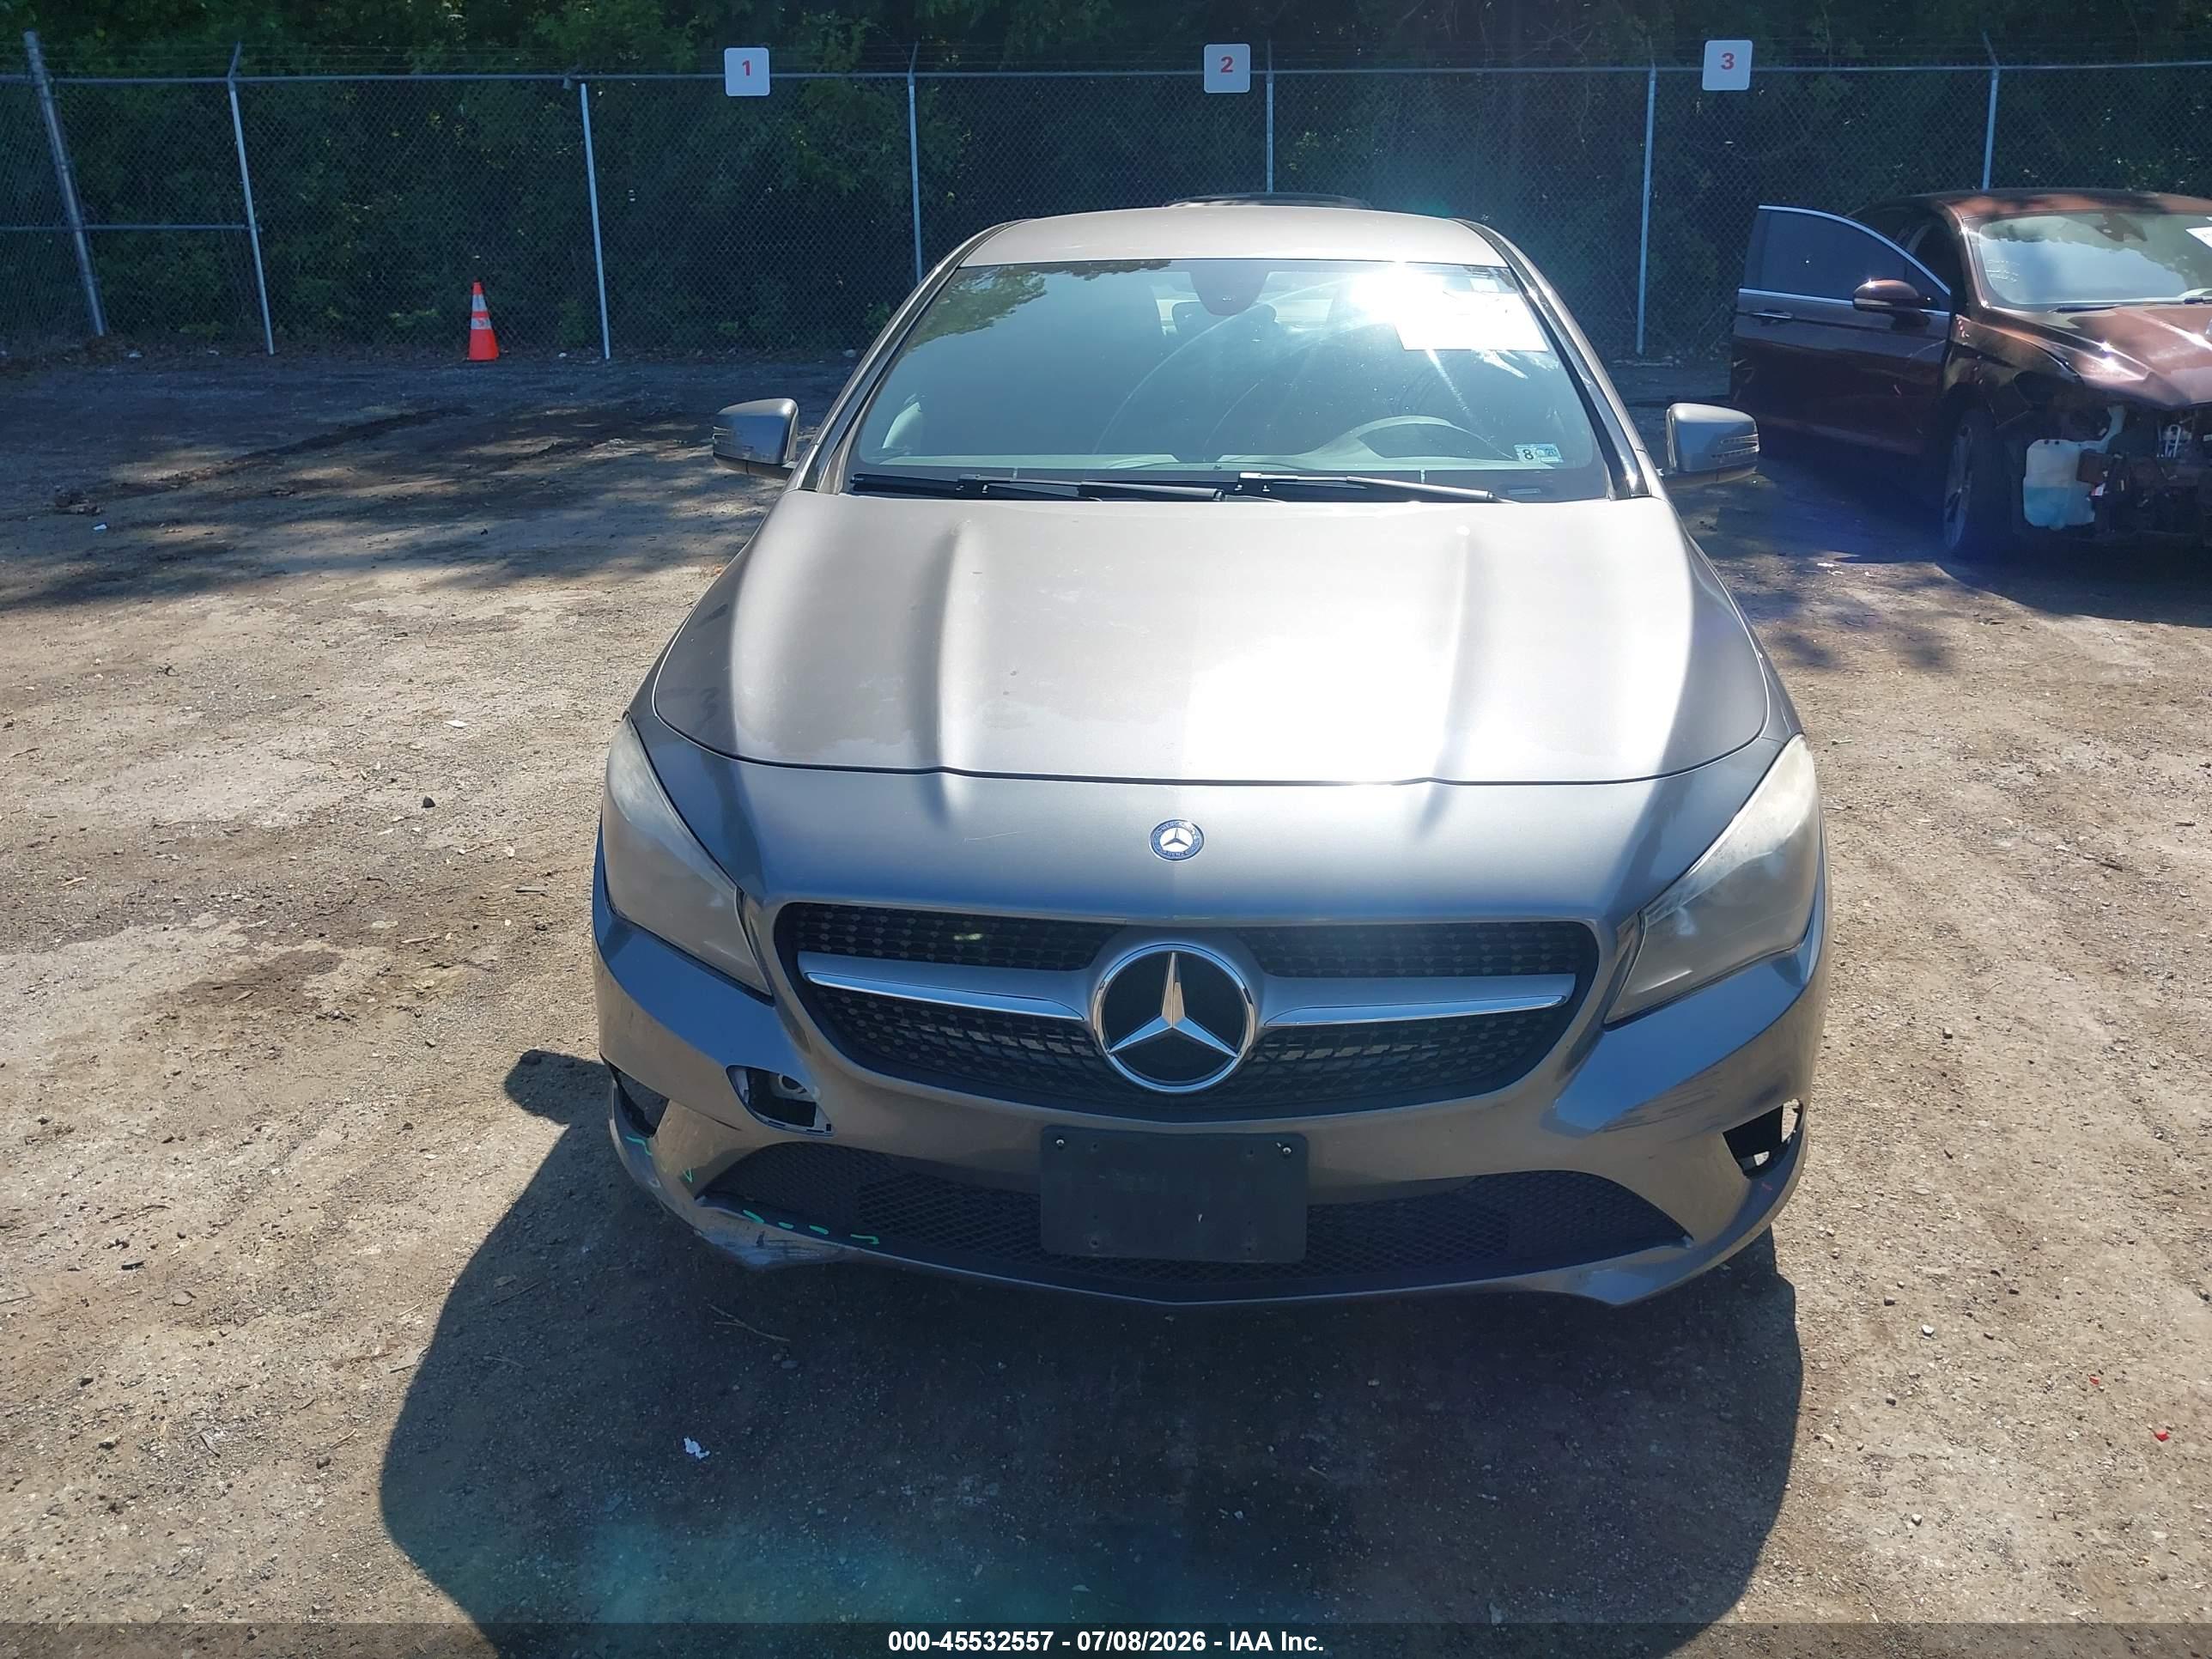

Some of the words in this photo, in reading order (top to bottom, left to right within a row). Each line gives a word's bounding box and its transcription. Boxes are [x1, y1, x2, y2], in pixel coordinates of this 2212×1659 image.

[742, 60, 750, 76] 1
[1220, 56, 1234, 73] 2
[1721, 52, 1735, 70] 3
[1522, 449, 1534, 460] 8
